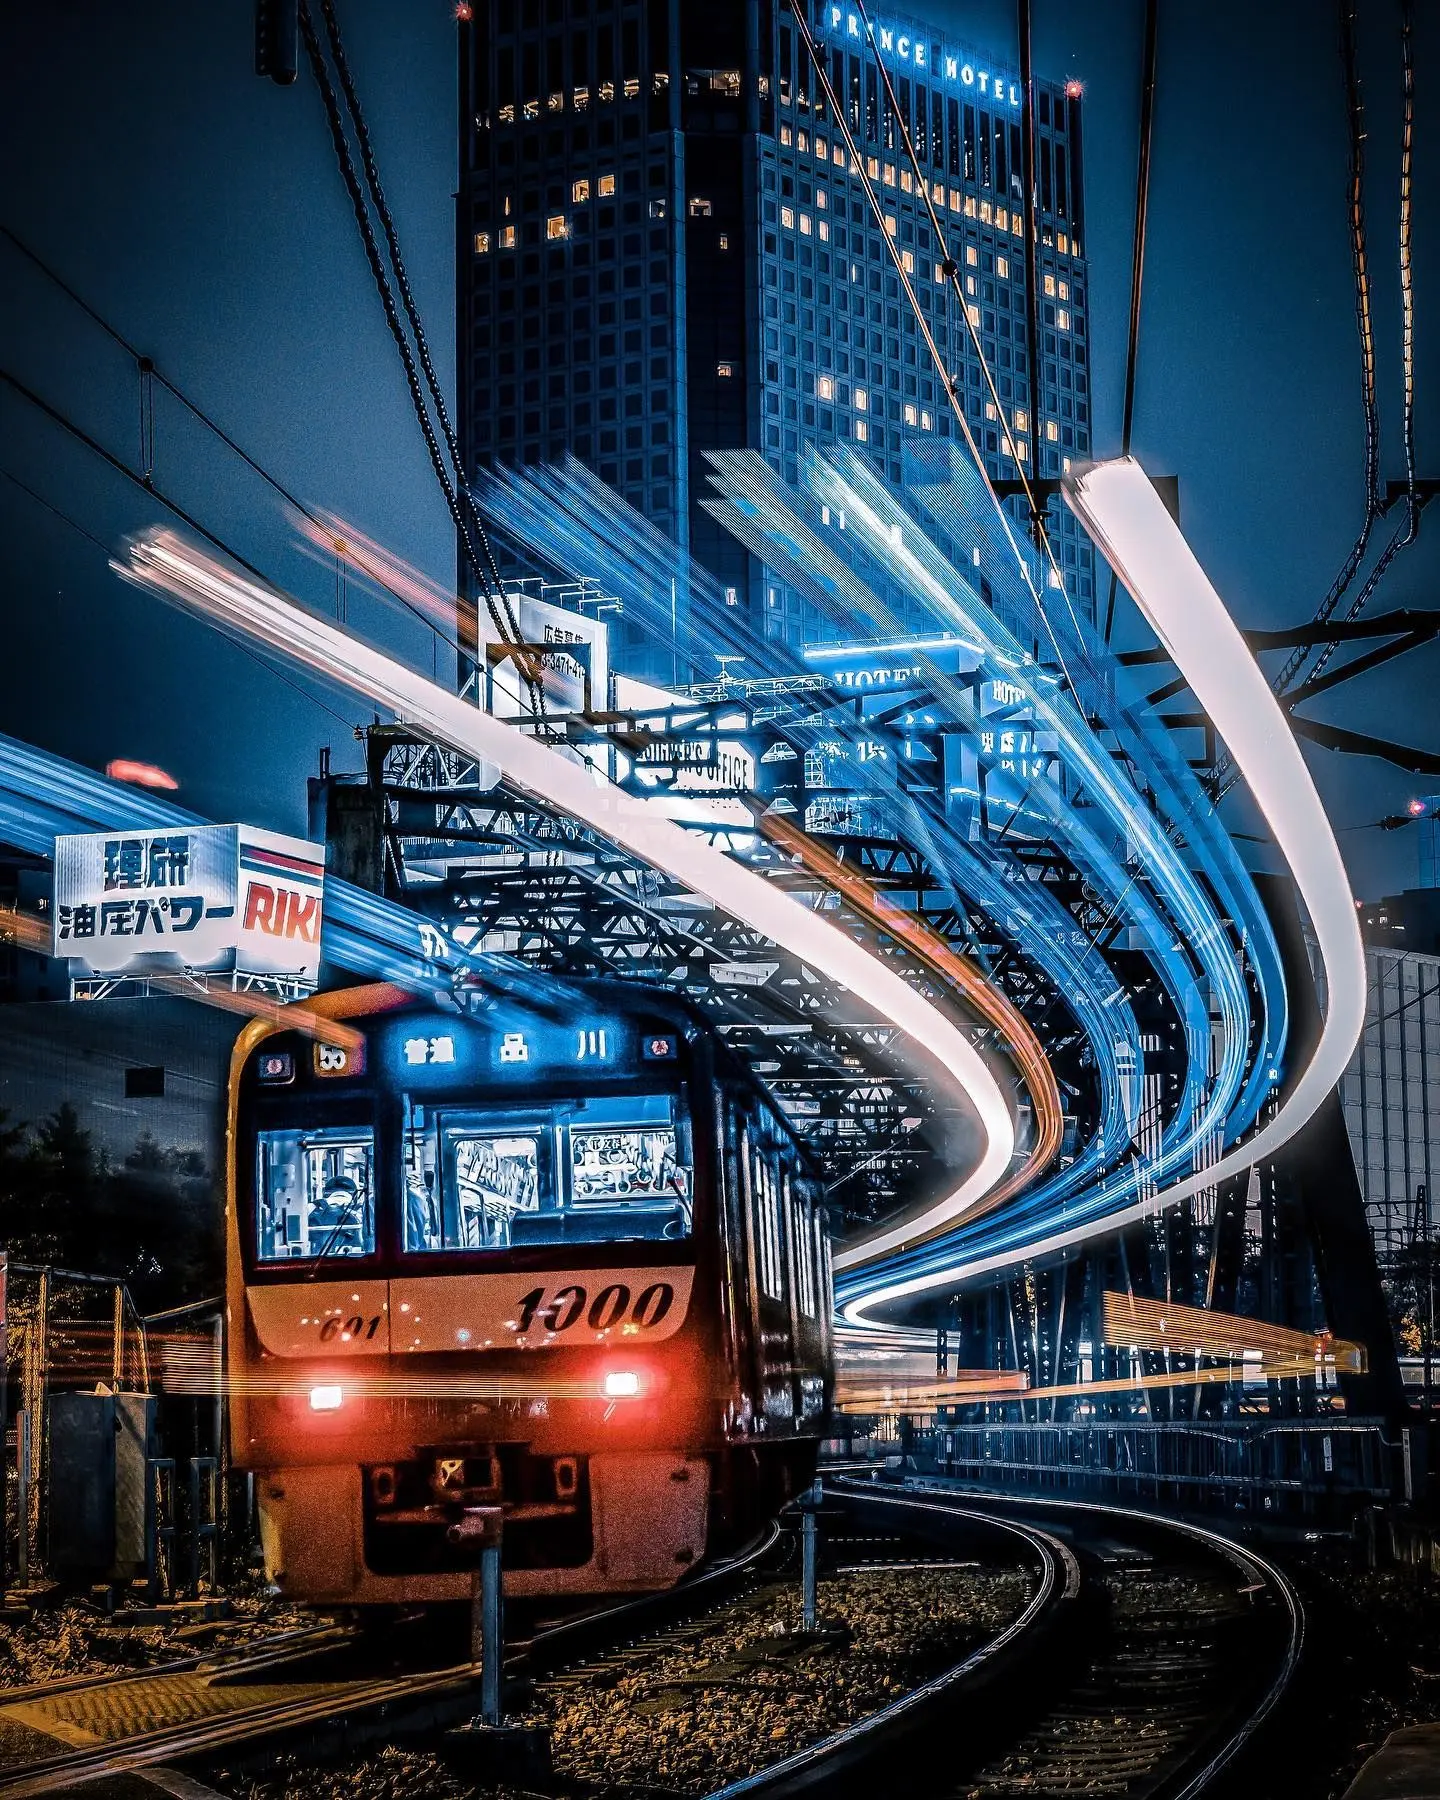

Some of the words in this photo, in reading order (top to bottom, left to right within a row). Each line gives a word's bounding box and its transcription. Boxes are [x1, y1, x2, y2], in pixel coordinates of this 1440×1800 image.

[945, 56, 1019, 106] HOTEL
[104, 836, 190, 890] 理研
[59, 896, 236, 939] 油圧パワー
[516, 1283, 675, 1332] 1000
